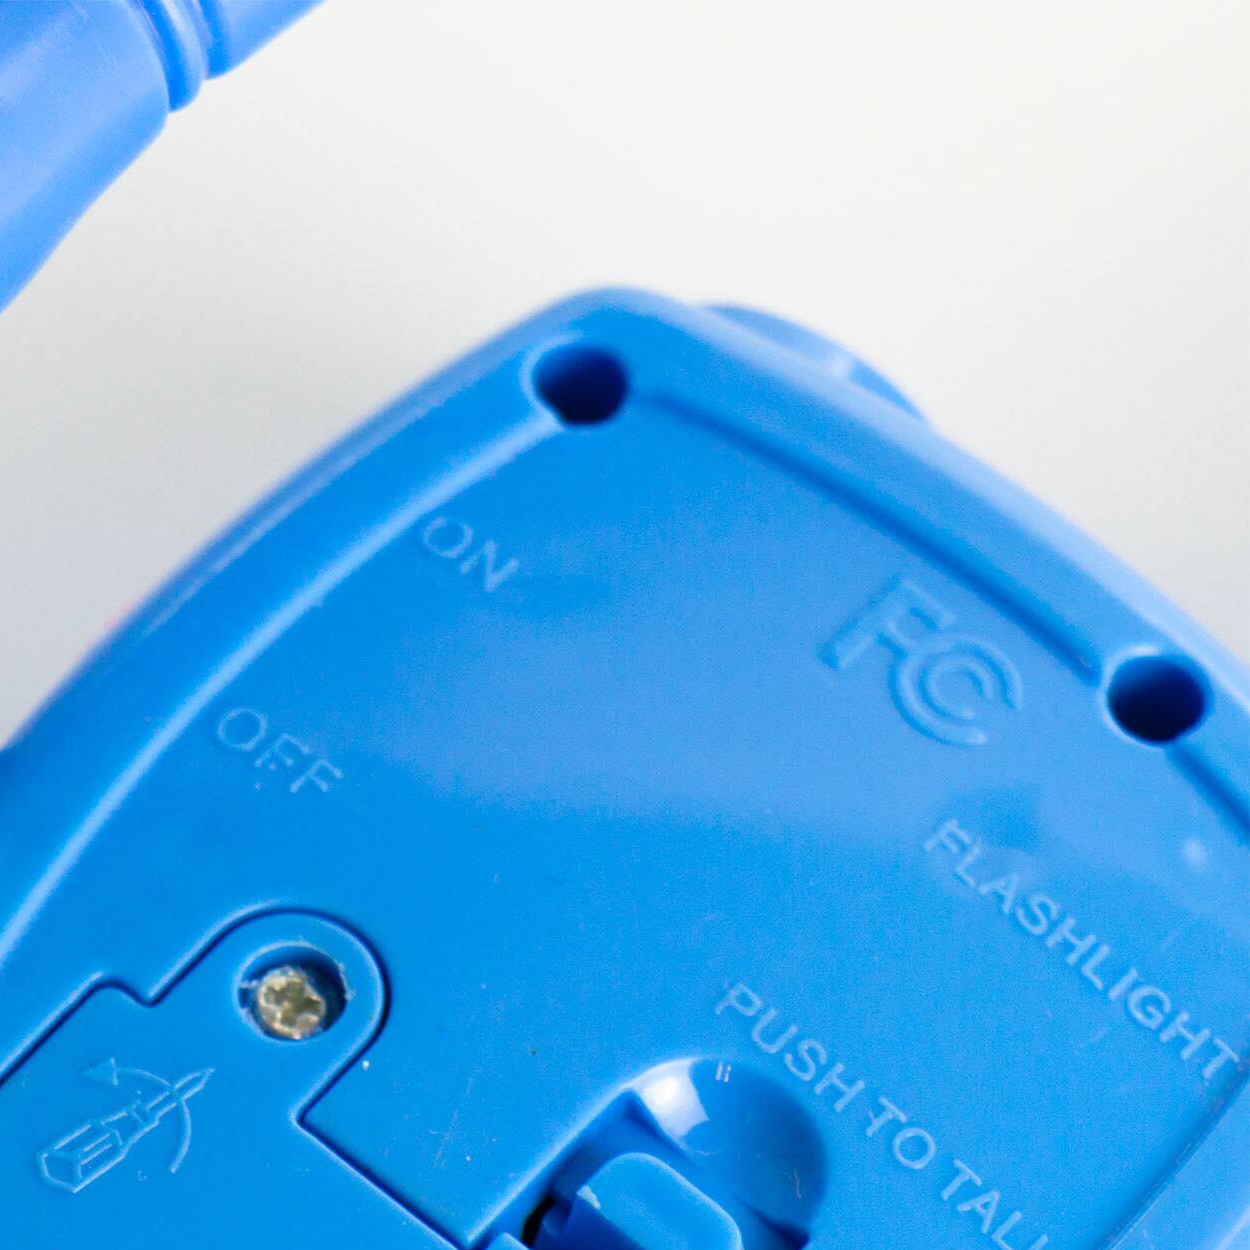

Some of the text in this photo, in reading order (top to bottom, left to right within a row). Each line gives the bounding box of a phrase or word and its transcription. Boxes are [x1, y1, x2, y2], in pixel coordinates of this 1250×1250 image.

[422, 515, 520, 592] ON
[217, 707, 344, 793] OFF
[924, 818, 1240, 1080] FLASHLIGHT
[714, 980, 865, 1112] PUSH
[865, 1096, 936, 1169] TO
